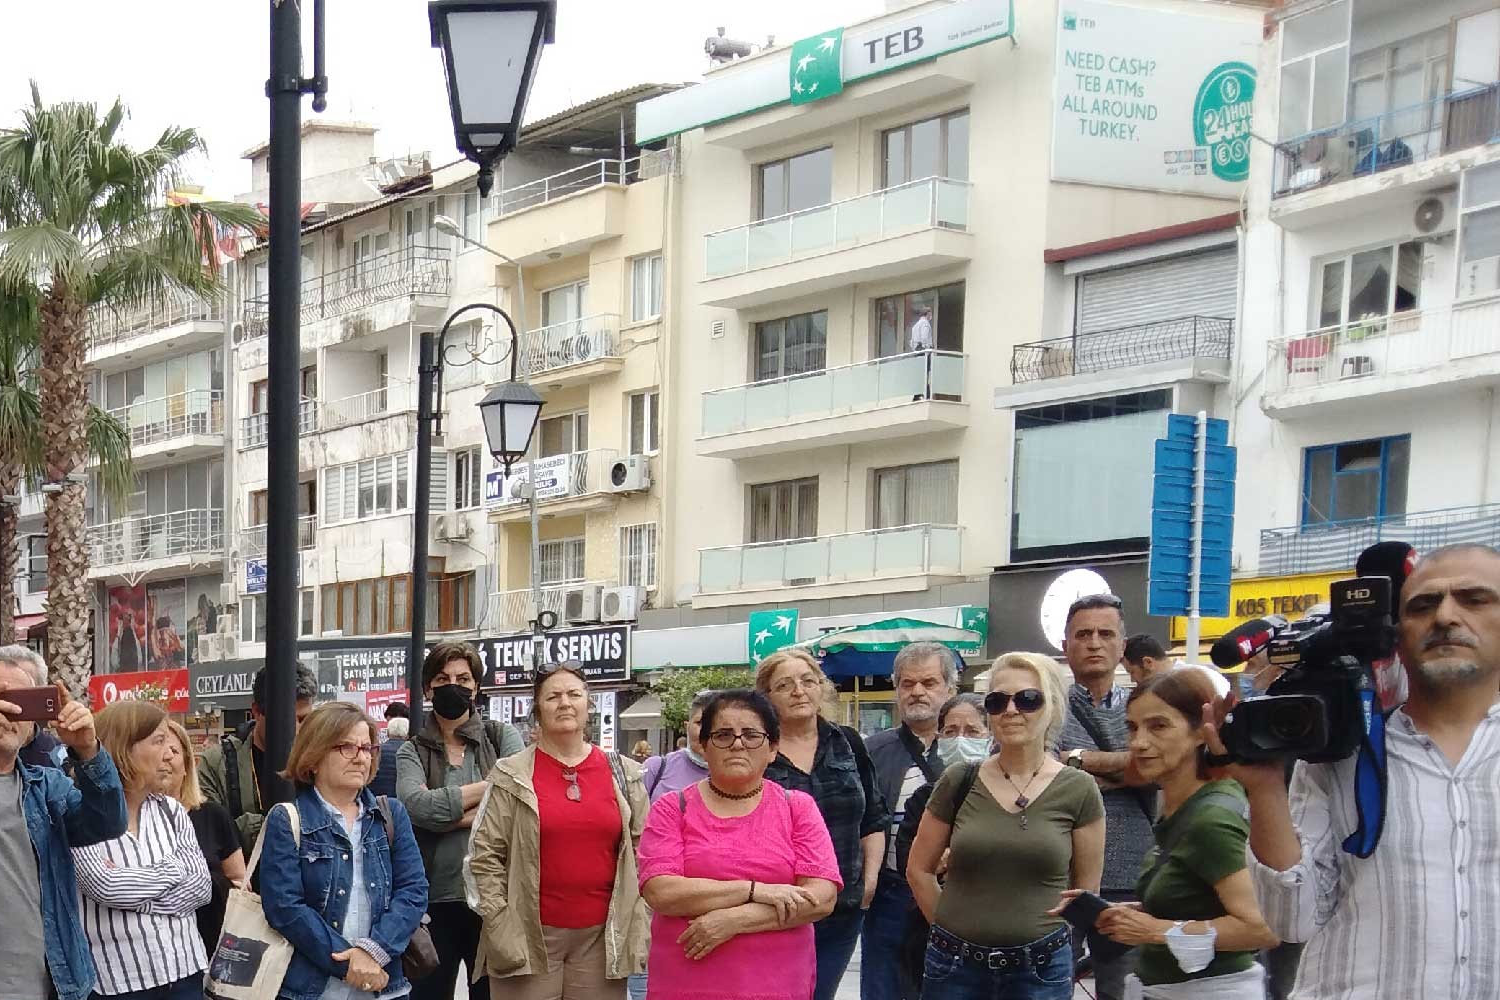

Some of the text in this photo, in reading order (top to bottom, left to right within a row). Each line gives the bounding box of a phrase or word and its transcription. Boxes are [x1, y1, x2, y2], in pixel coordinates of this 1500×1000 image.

[863, 26, 924, 64] TEB
[1065, 50, 1157, 78] NEED CASH?
[1076, 73, 1145, 98] TEB ATMs
[1062, 95, 1158, 121] ALL AROUND
[1204, 106, 1228, 136] 24
[1079, 118, 1140, 142] TURKEY.
[1347, 588, 1371, 600] HD
[494, 637, 552, 668] TEKNK
